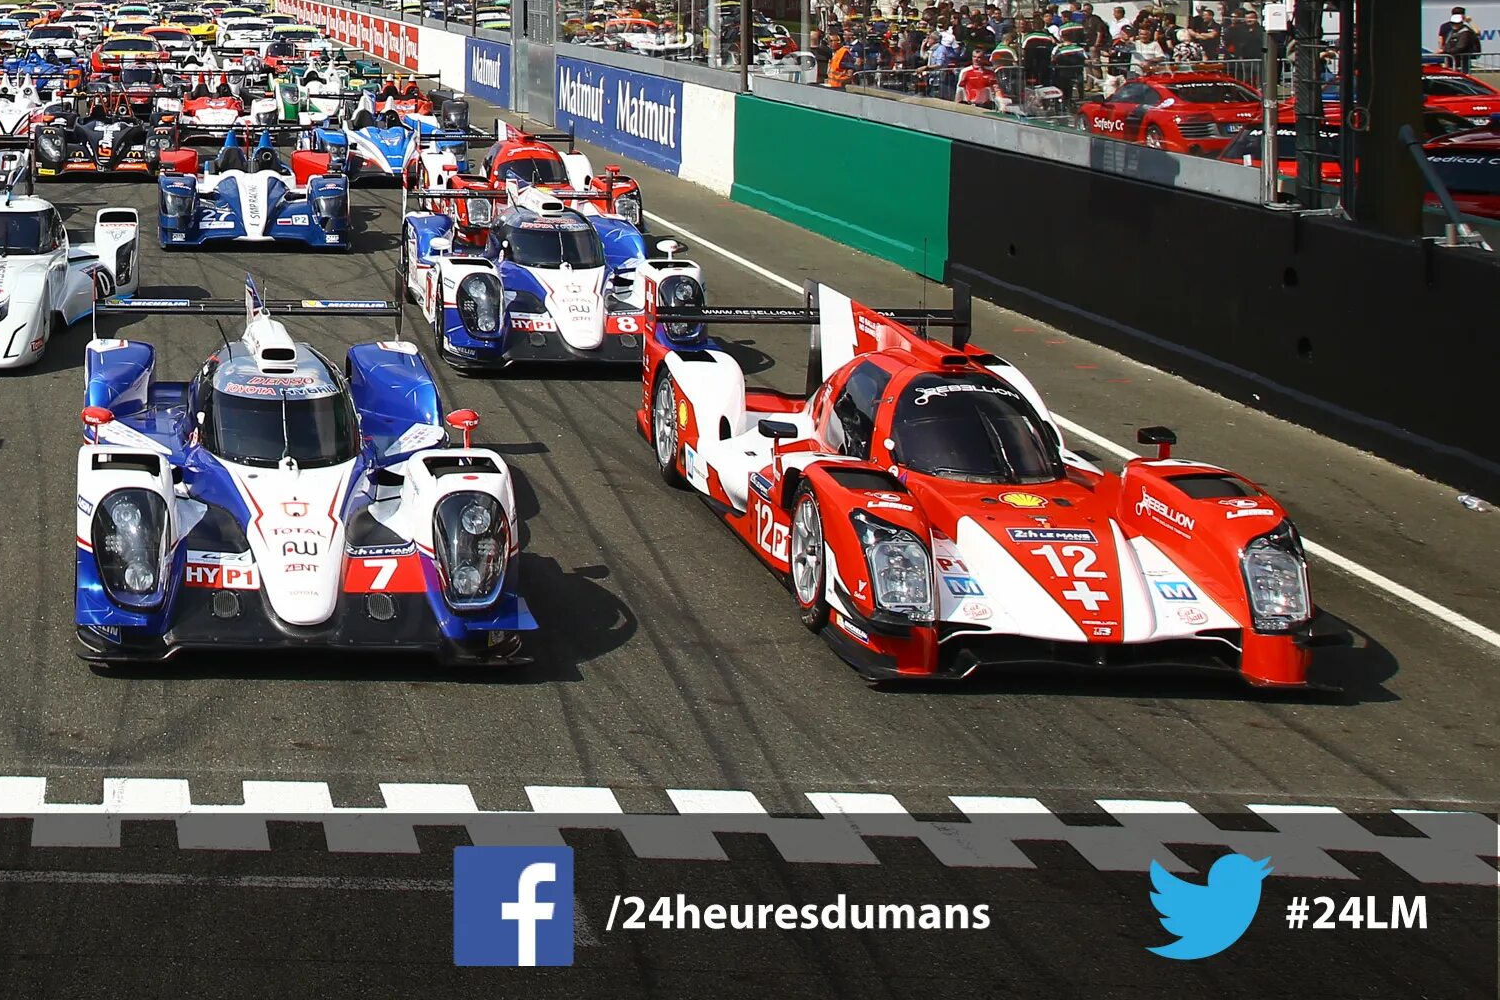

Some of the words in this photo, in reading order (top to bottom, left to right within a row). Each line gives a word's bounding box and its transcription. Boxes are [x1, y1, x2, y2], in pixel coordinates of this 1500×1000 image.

[472, 46, 501, 89] Matmut
[559, 66, 605, 125] Matmut
[616, 79, 676, 149] Matmut
[1094, 116, 1114, 132] Safety
[202, 210, 231, 221] 27
[511, 320, 532, 329] HY
[536, 321, 552, 330] P1
[616, 317, 638, 333] 8
[248, 376, 315, 385] DENSO
[225, 382, 277, 395] TOYOTA
[280, 384, 338, 396] HYBRID
[922, 385, 1020, 400] REBELLION
[867, 501, 913, 512] LEMO
[1142, 493, 1195, 531] REBELLION
[1226, 509, 1274, 519] LEMO
[272, 528, 325, 538] TOTAL
[755, 499, 774, 554] 12
[775, 532, 789, 559] P1
[1012, 529, 1038, 539] 24h
[284, 564, 319, 573] ZENT
[938, 557, 968, 572] P1
[1031, 545, 1108, 579] 12
[187, 565, 219, 584] HY
[227, 569, 254, 584] P1
[363, 559, 398, 590] 7
